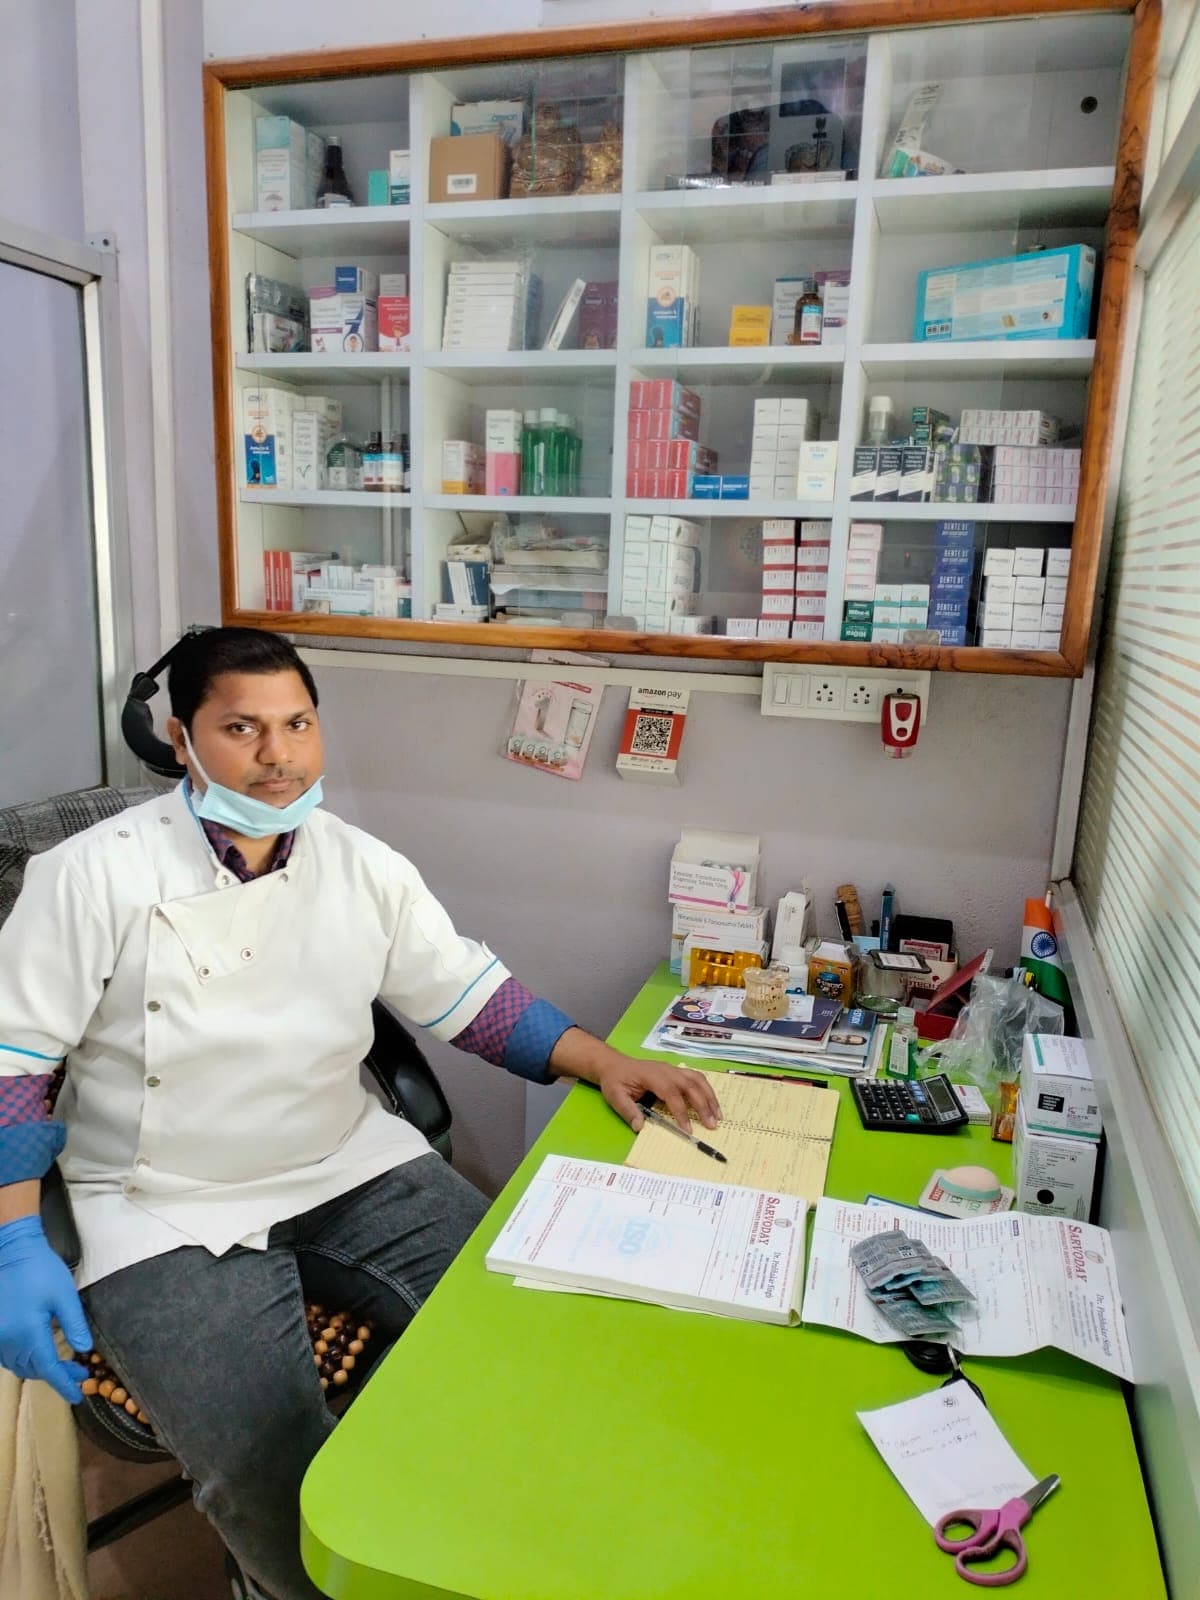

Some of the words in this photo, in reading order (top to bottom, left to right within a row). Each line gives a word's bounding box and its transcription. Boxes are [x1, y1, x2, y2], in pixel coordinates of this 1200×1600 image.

[637, 687, 667, 696] amazon
[667, 690, 682, 699] pay
[759, 1196, 780, 1246] SARVODAY
[1068, 1225, 1088, 1282] SARVODAY
